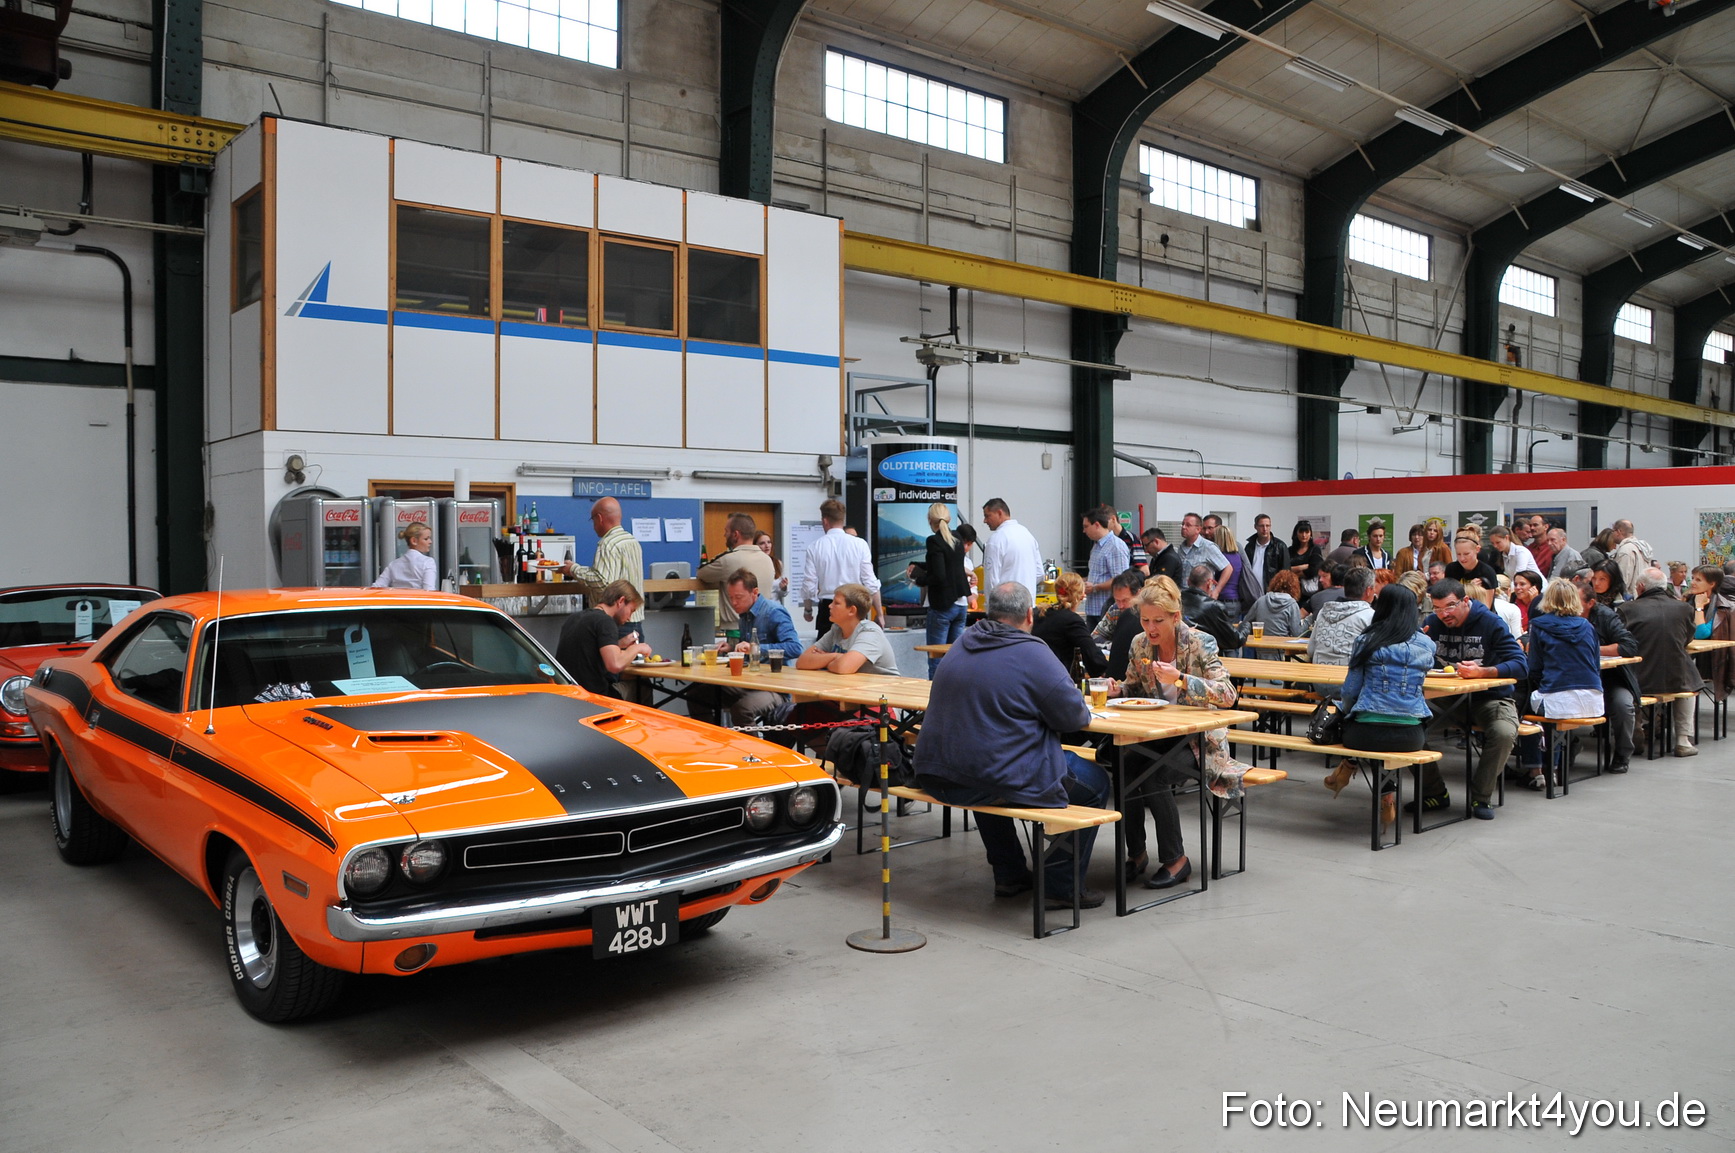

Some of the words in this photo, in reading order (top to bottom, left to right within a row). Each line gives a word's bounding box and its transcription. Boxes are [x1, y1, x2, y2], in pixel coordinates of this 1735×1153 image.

[578, 481, 647, 496] INFO-TAFEL
[555, 771, 666, 793] DODGE
[225, 875, 235, 921] COBRA
[615, 899, 659, 928] WWT
[226, 925, 244, 980] COOPER
[608, 922, 667, 954] 428J
